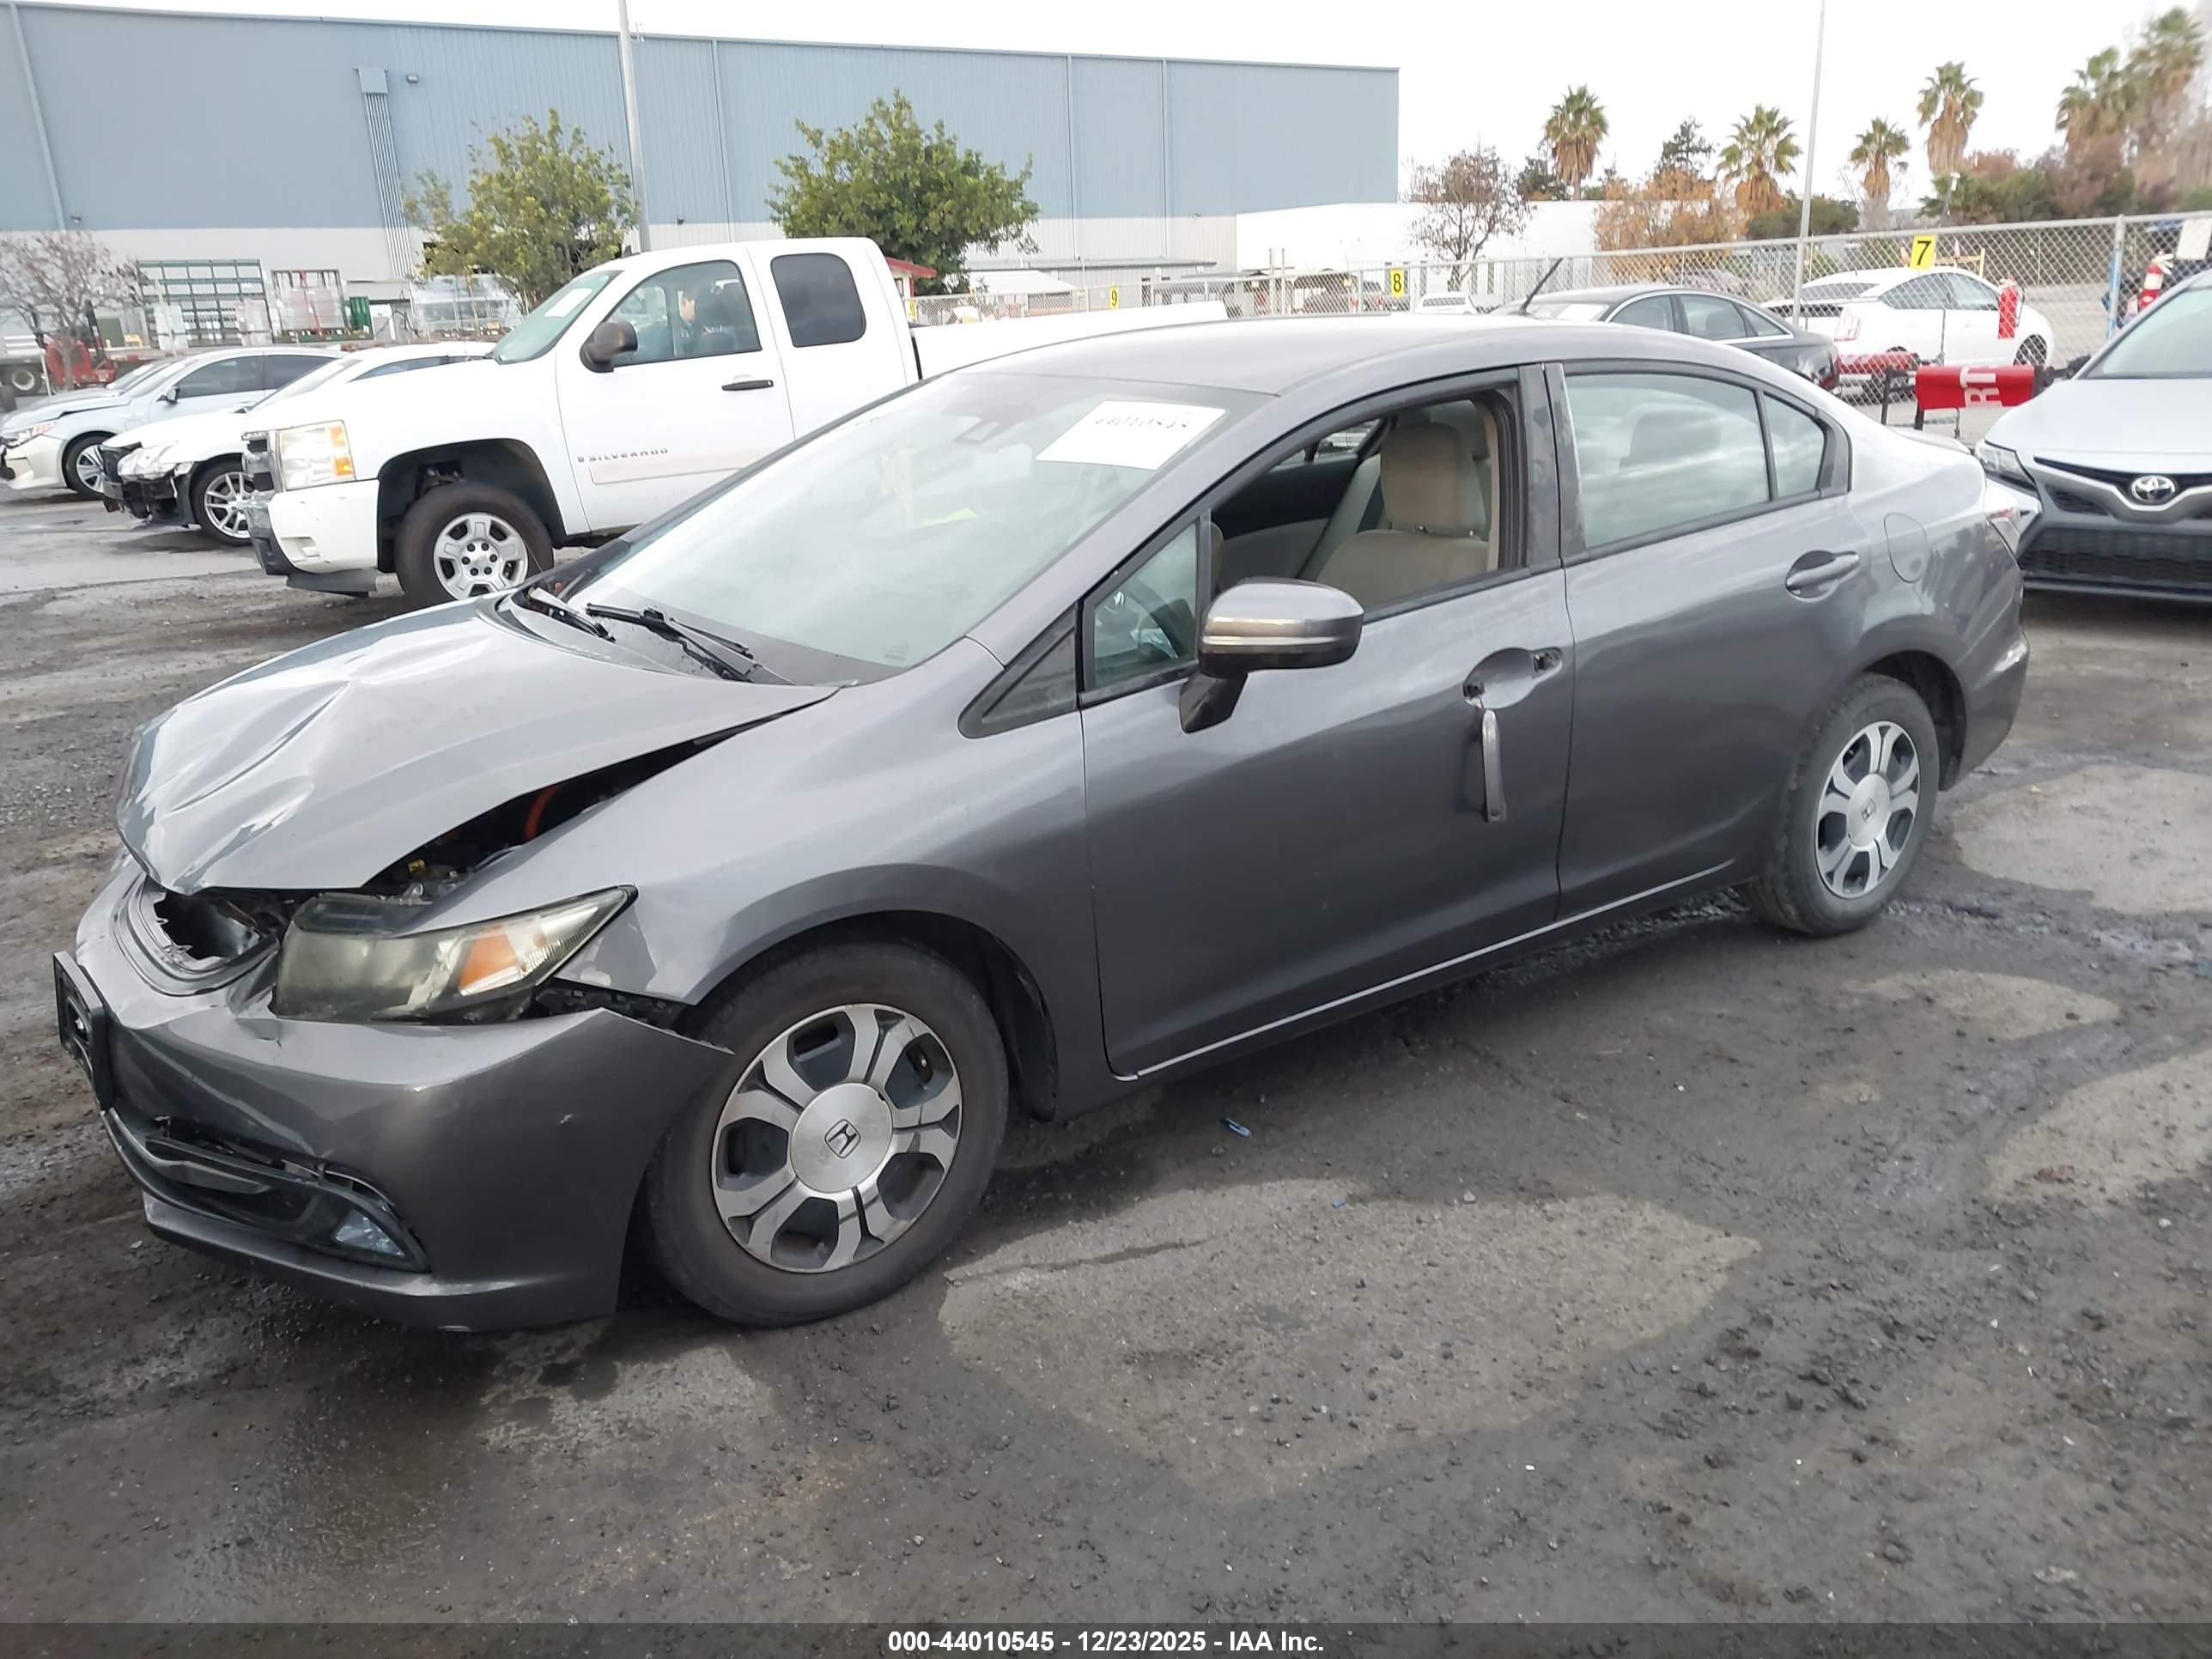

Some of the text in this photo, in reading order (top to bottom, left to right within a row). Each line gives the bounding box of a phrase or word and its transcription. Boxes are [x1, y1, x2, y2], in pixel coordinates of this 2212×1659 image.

[1917, 240, 1932, 266] 7
[1393, 273, 1401, 293] 8
[1111, 289, 1118, 307] 9
[589, 447, 668, 462] SILVERADO
